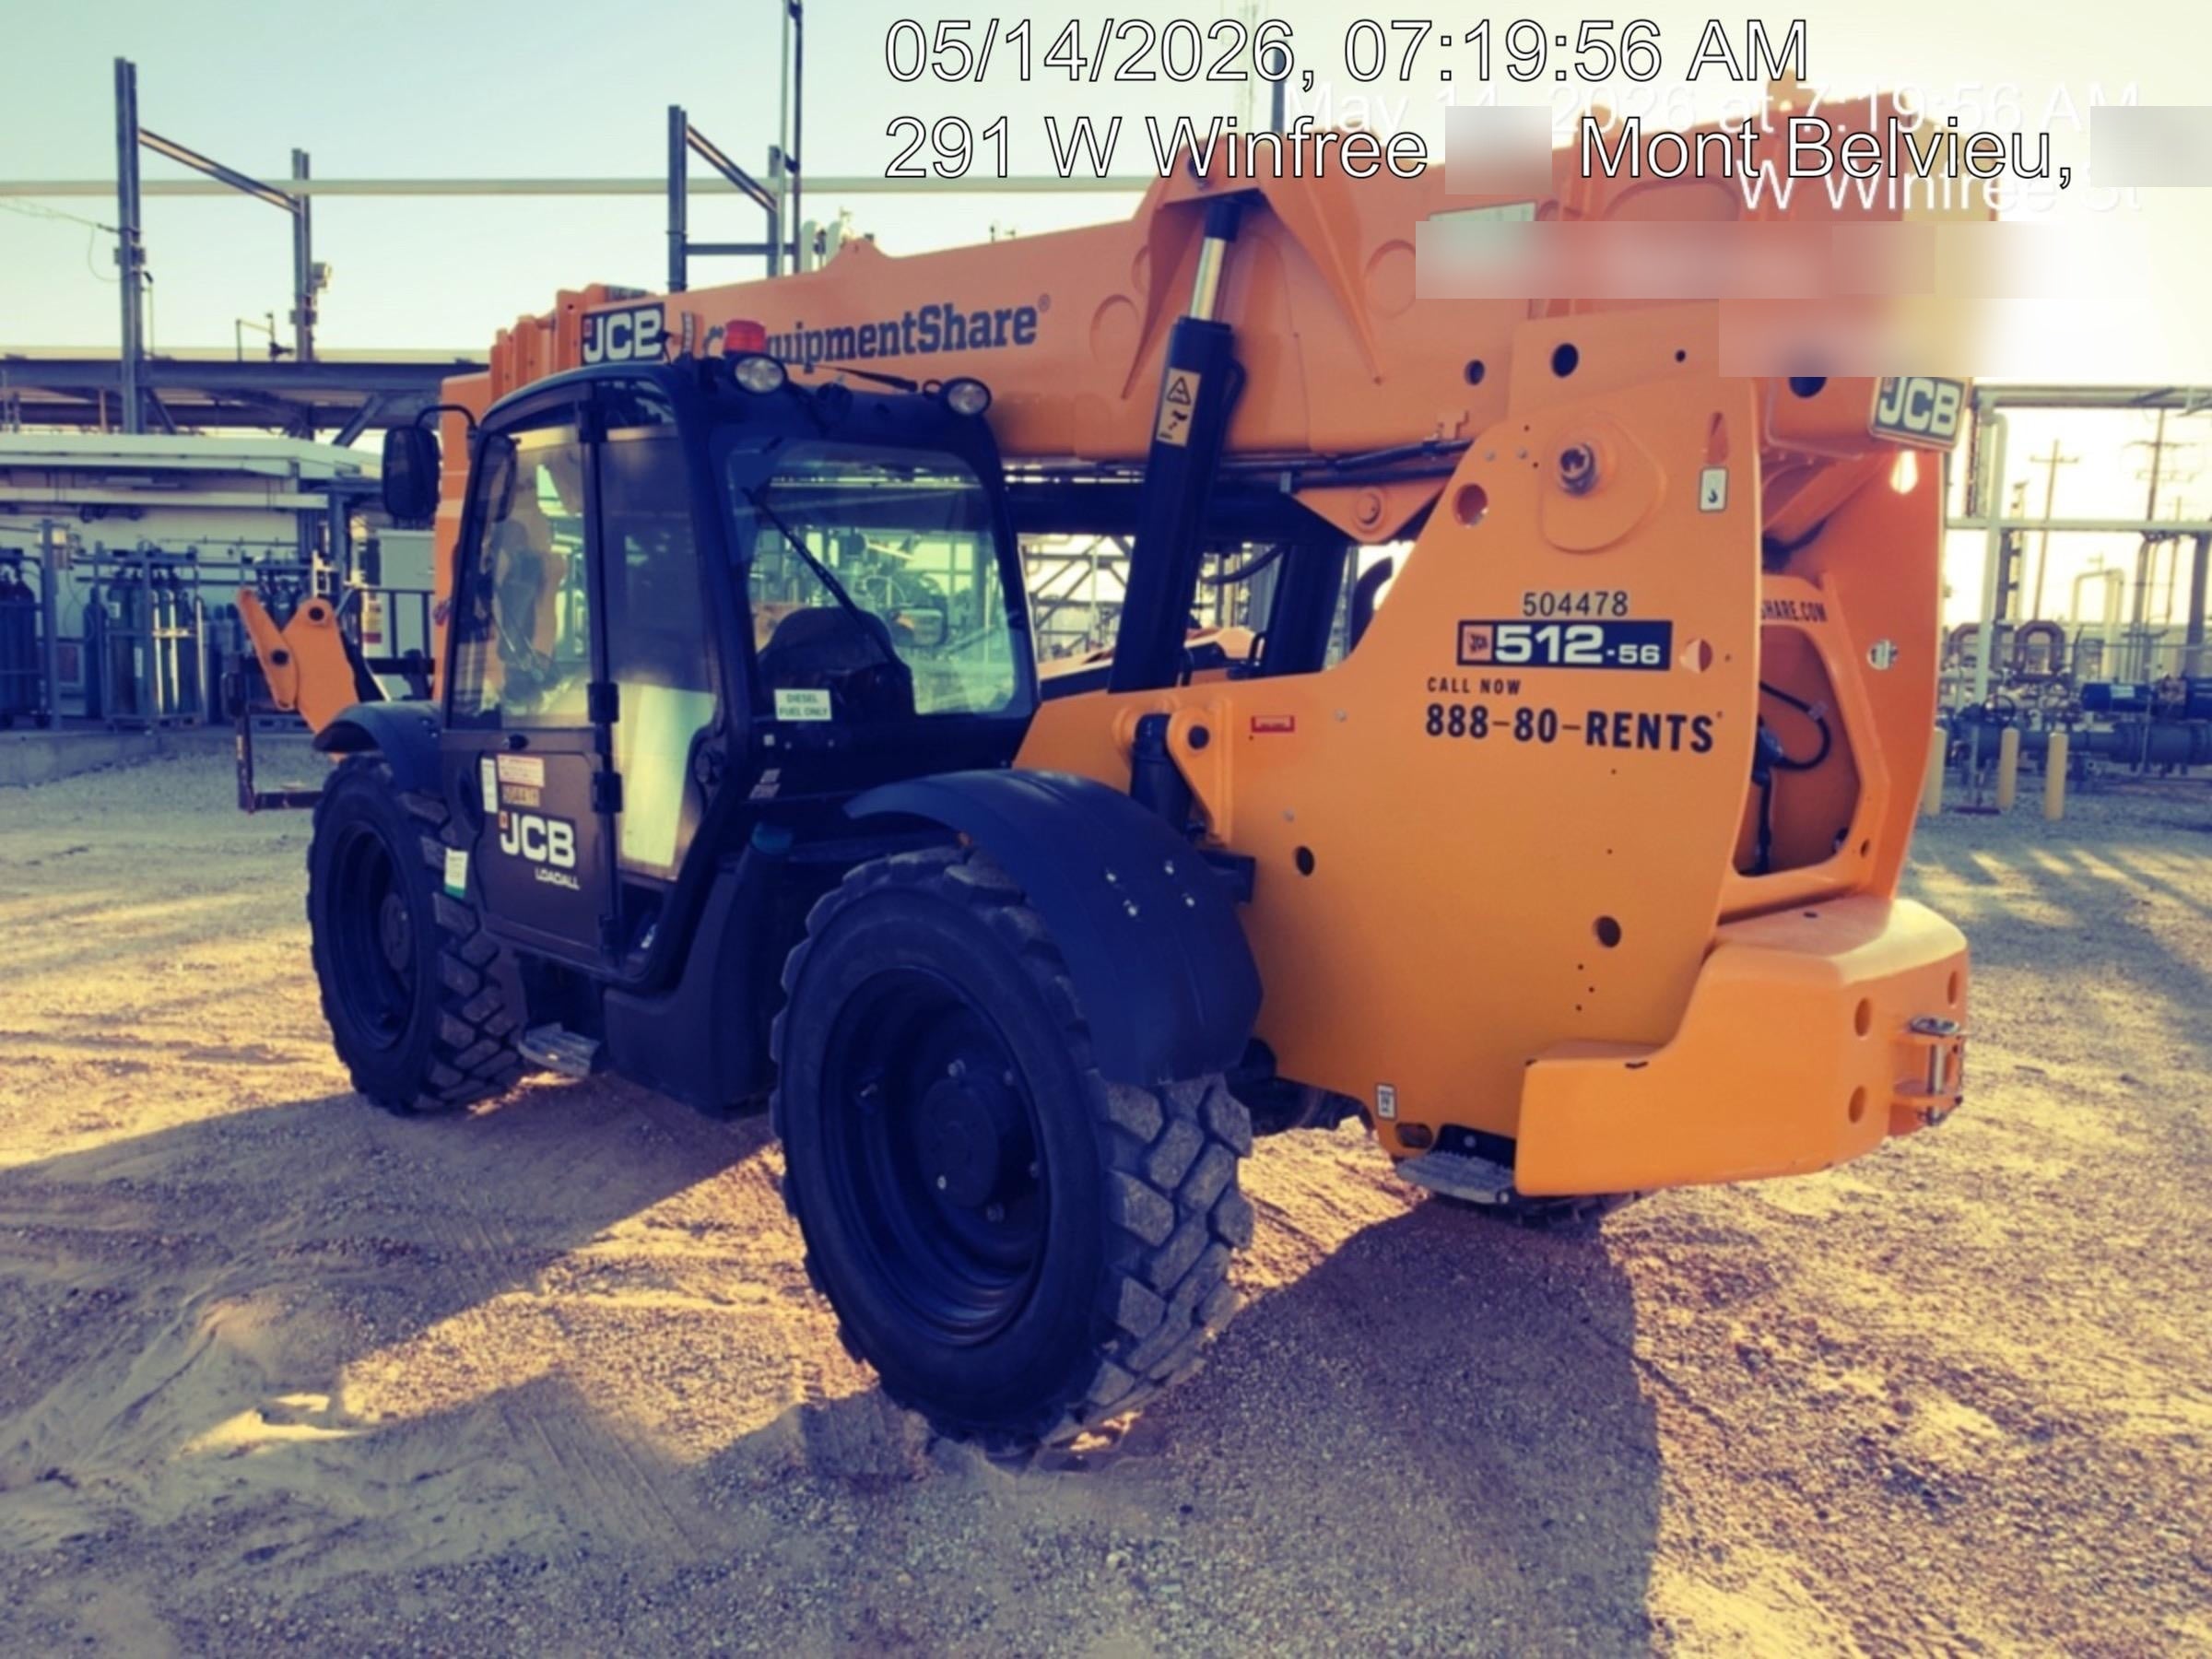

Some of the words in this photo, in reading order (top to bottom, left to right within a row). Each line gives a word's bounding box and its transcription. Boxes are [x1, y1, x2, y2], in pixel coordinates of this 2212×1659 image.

[582, 308, 662, 363] JCB
[766, 304, 1038, 374] uipmentShare
[1878, 377, 1960, 436] JCB
[1523, 590, 1629, 617] 504478
[1427, 677, 1471, 693] CALL
[1479, 678, 1522, 696] NOW
[500, 812, 576, 868] JCB
